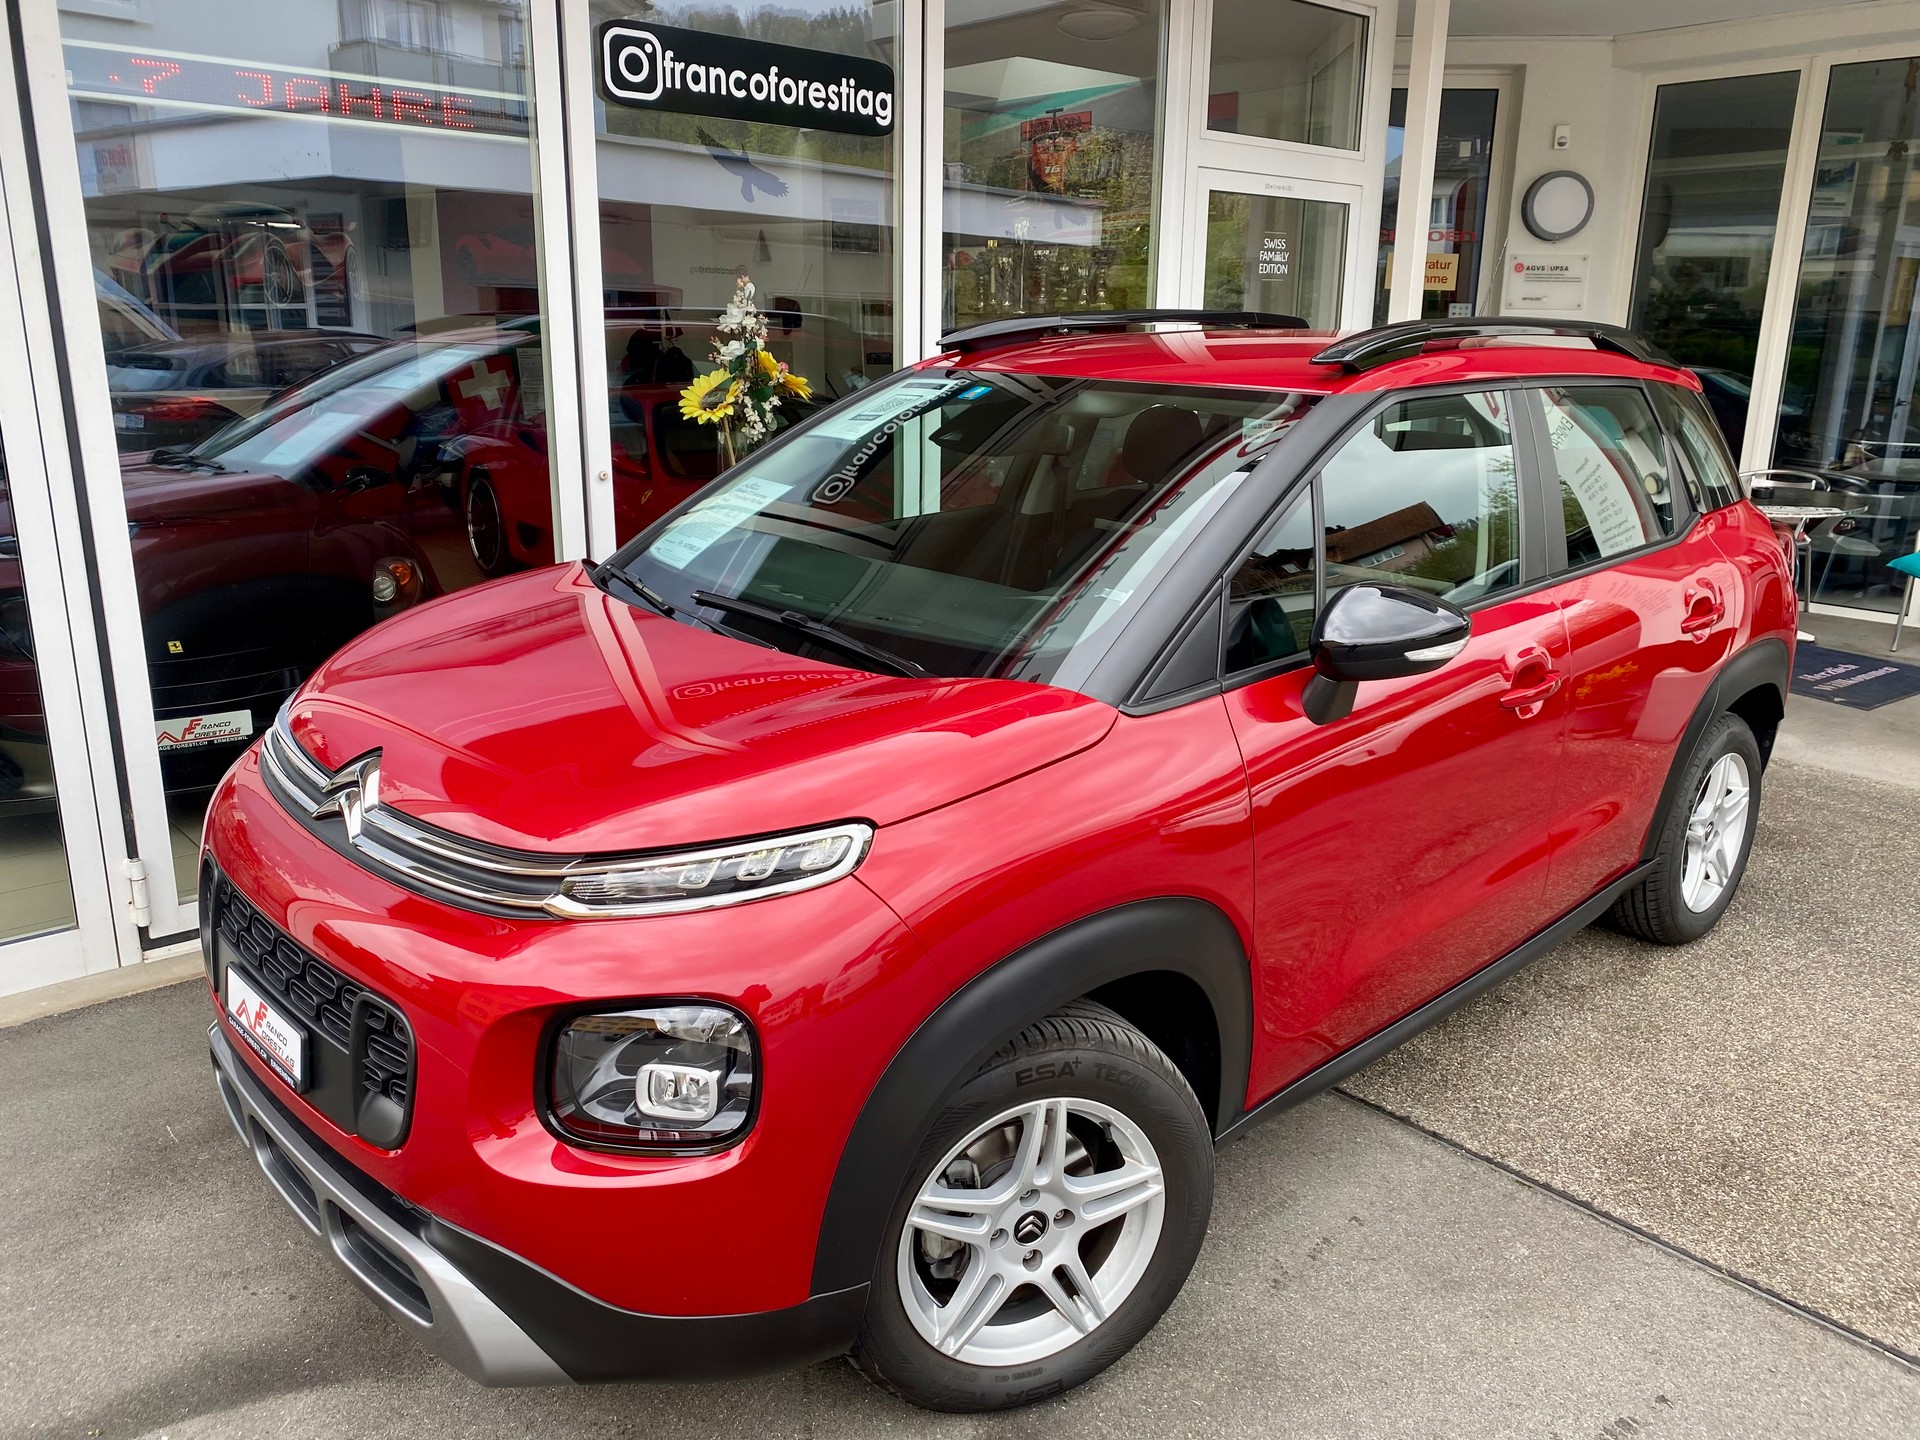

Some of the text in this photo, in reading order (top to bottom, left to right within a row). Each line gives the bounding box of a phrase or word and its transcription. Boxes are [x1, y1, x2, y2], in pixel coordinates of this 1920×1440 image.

[663, 50, 893, 127] francoforestiag
[235, 71, 476, 128] JAHRE
[1263, 238, 1286, 249] SWISS
[1258, 264, 1288, 274] EDITION
[213, 736, 248, 744] ERMENSWIL
[284, 1056, 295, 1068] AG
[1094, 1062, 1152, 1097] TECAR
